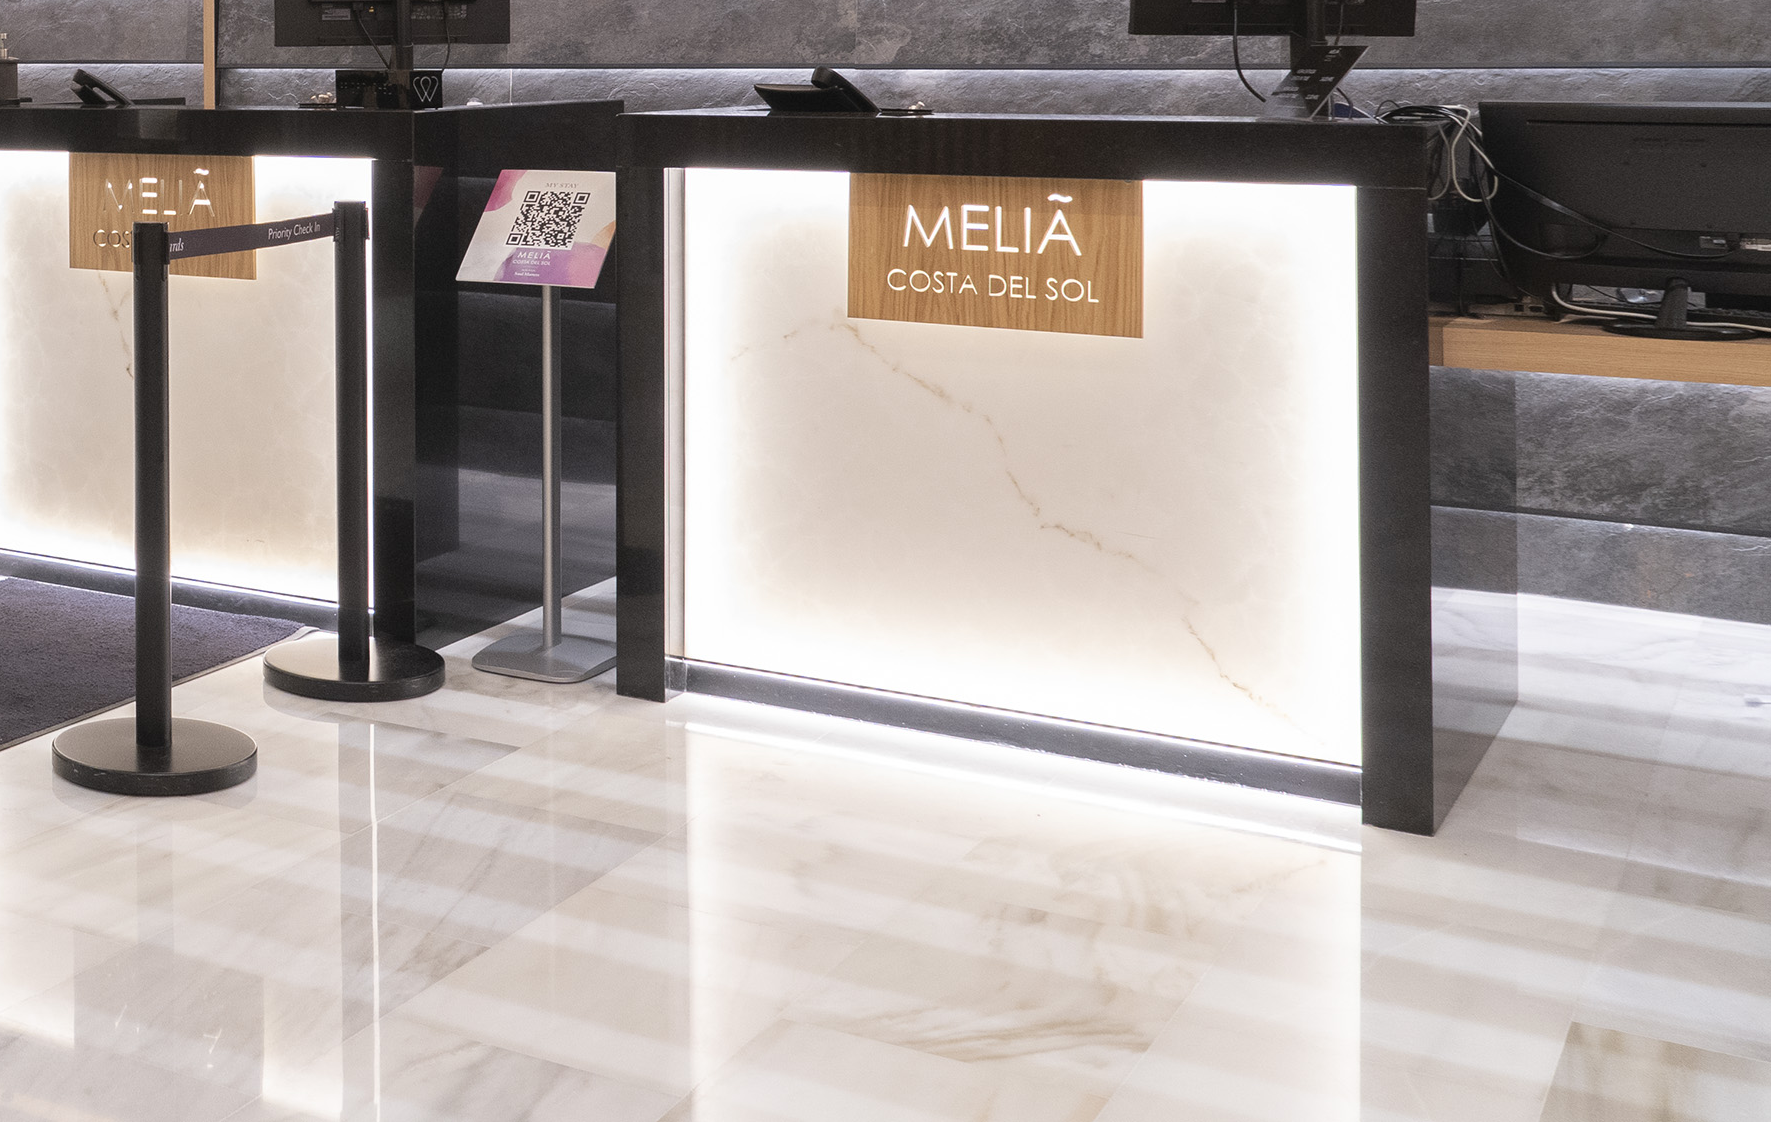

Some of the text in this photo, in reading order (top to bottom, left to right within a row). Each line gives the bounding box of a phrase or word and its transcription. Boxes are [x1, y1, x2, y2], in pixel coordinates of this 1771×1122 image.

[93, 228, 135, 249] COS
[268, 222, 321, 241] Priority Check In
[886, 268, 1100, 303] COSTA DEL SOL
